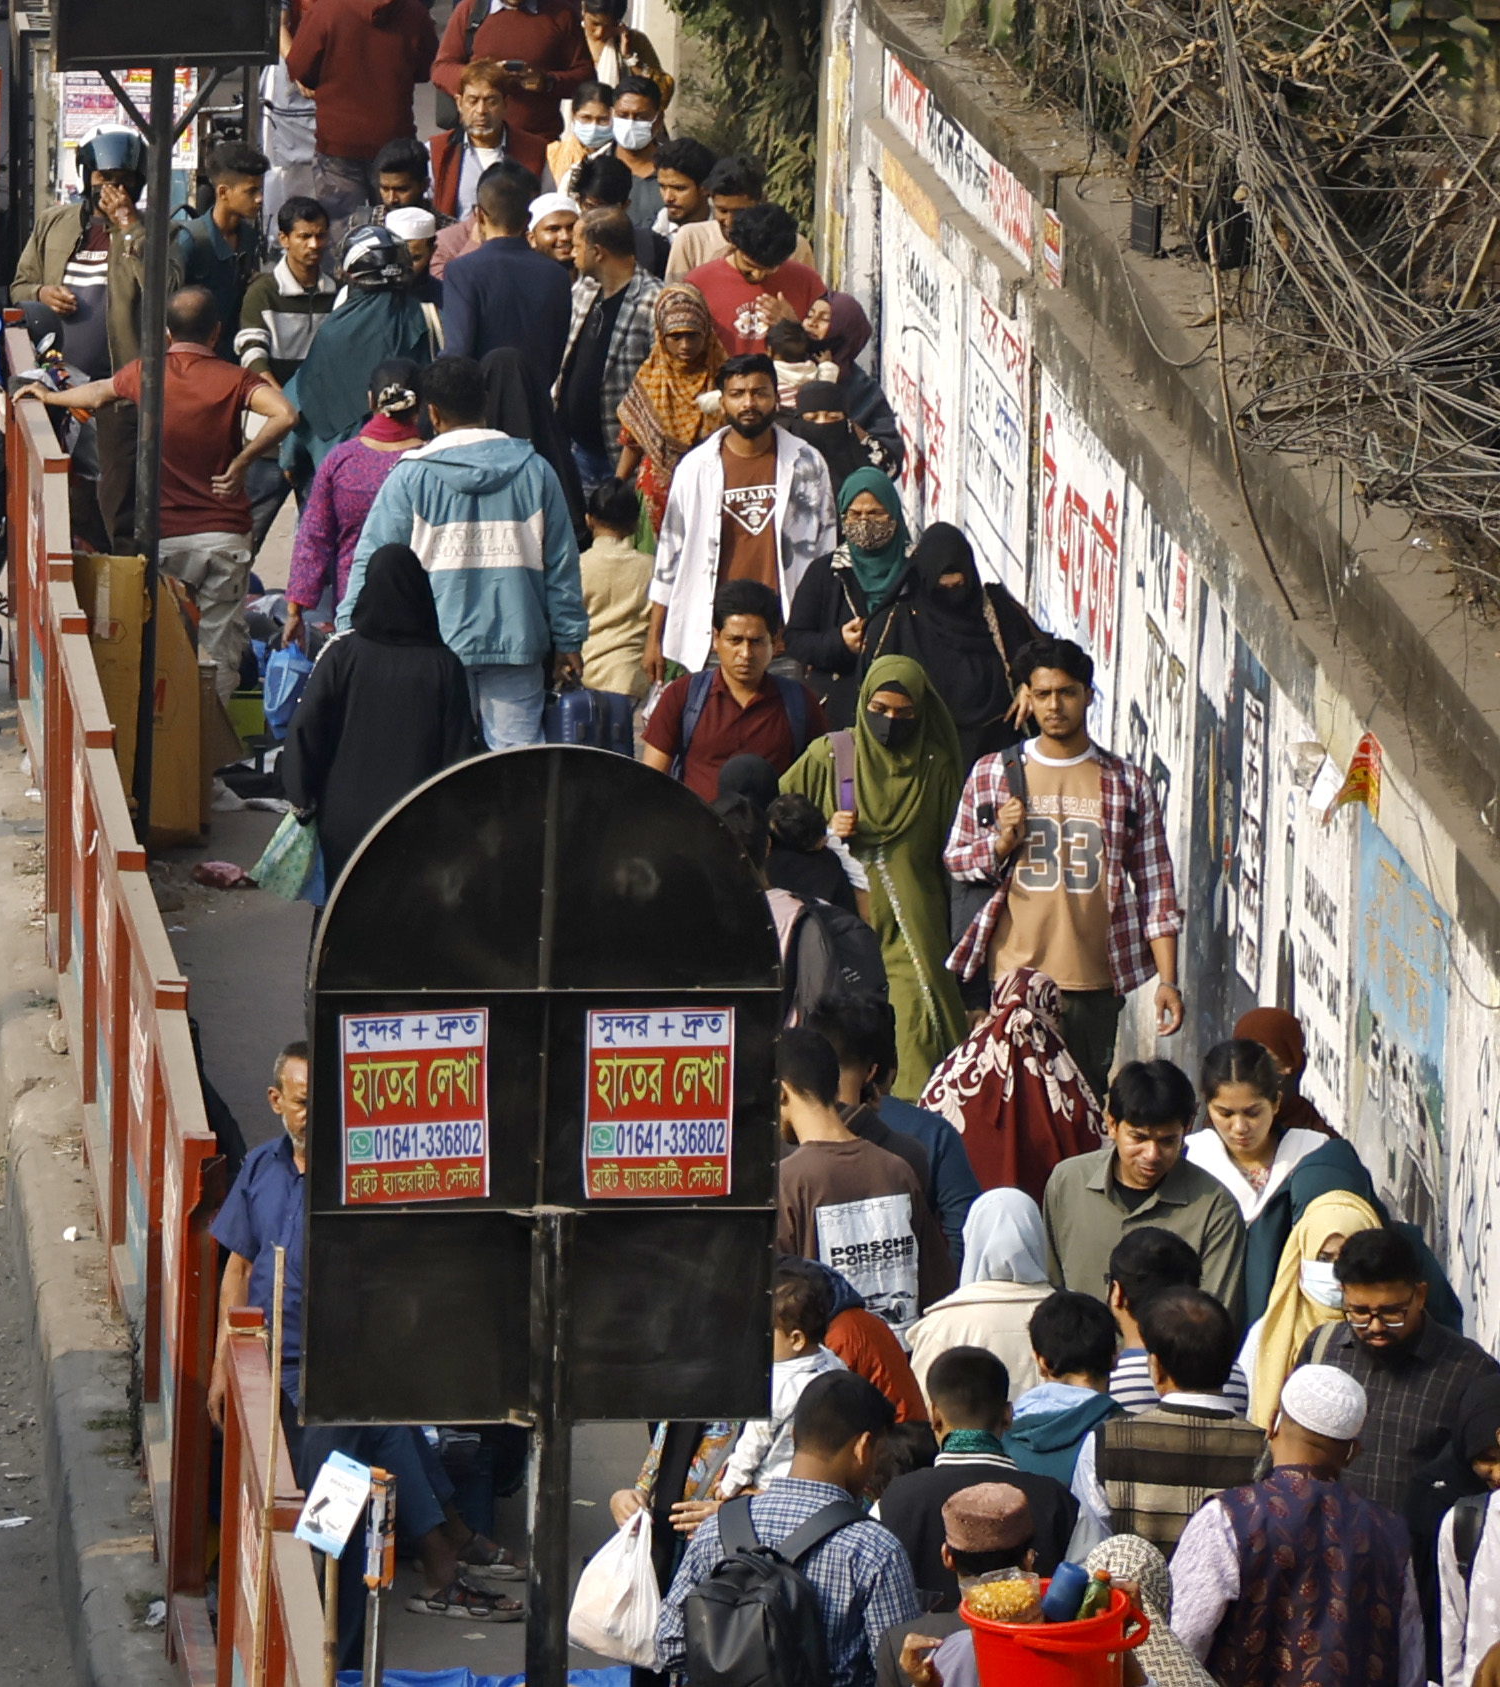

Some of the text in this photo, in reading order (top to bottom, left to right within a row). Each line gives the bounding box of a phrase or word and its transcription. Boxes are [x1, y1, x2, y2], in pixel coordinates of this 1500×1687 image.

[725, 488, 777, 505] PRADA
[1016, 816, 1104, 893] 33
[350, 1015, 480, 1049] সুন্দর + দ্রুত
[596, 1013, 726, 1044] সুন্দর + দ্রুত
[349, 1051, 481, 1120] হাতের লেখা
[595, 1050, 727, 1115] হাতের লেখা
[374, 1122, 482, 1161] 01641-336802
[616, 1121, 726, 1156] 01641-336802
[350, 1167, 379, 1198] ব্রাইট
[445, 1163, 480, 1190] সেন্টার
[592, 1163, 620, 1193] ব্রাইট
[687, 1162, 724, 1189] সেন্টার
[819, 1200, 892, 1219] PORSCHE
[830, 1235, 914, 1257] PORSCHE
[831, 1246, 914, 1267] PORSCHE
